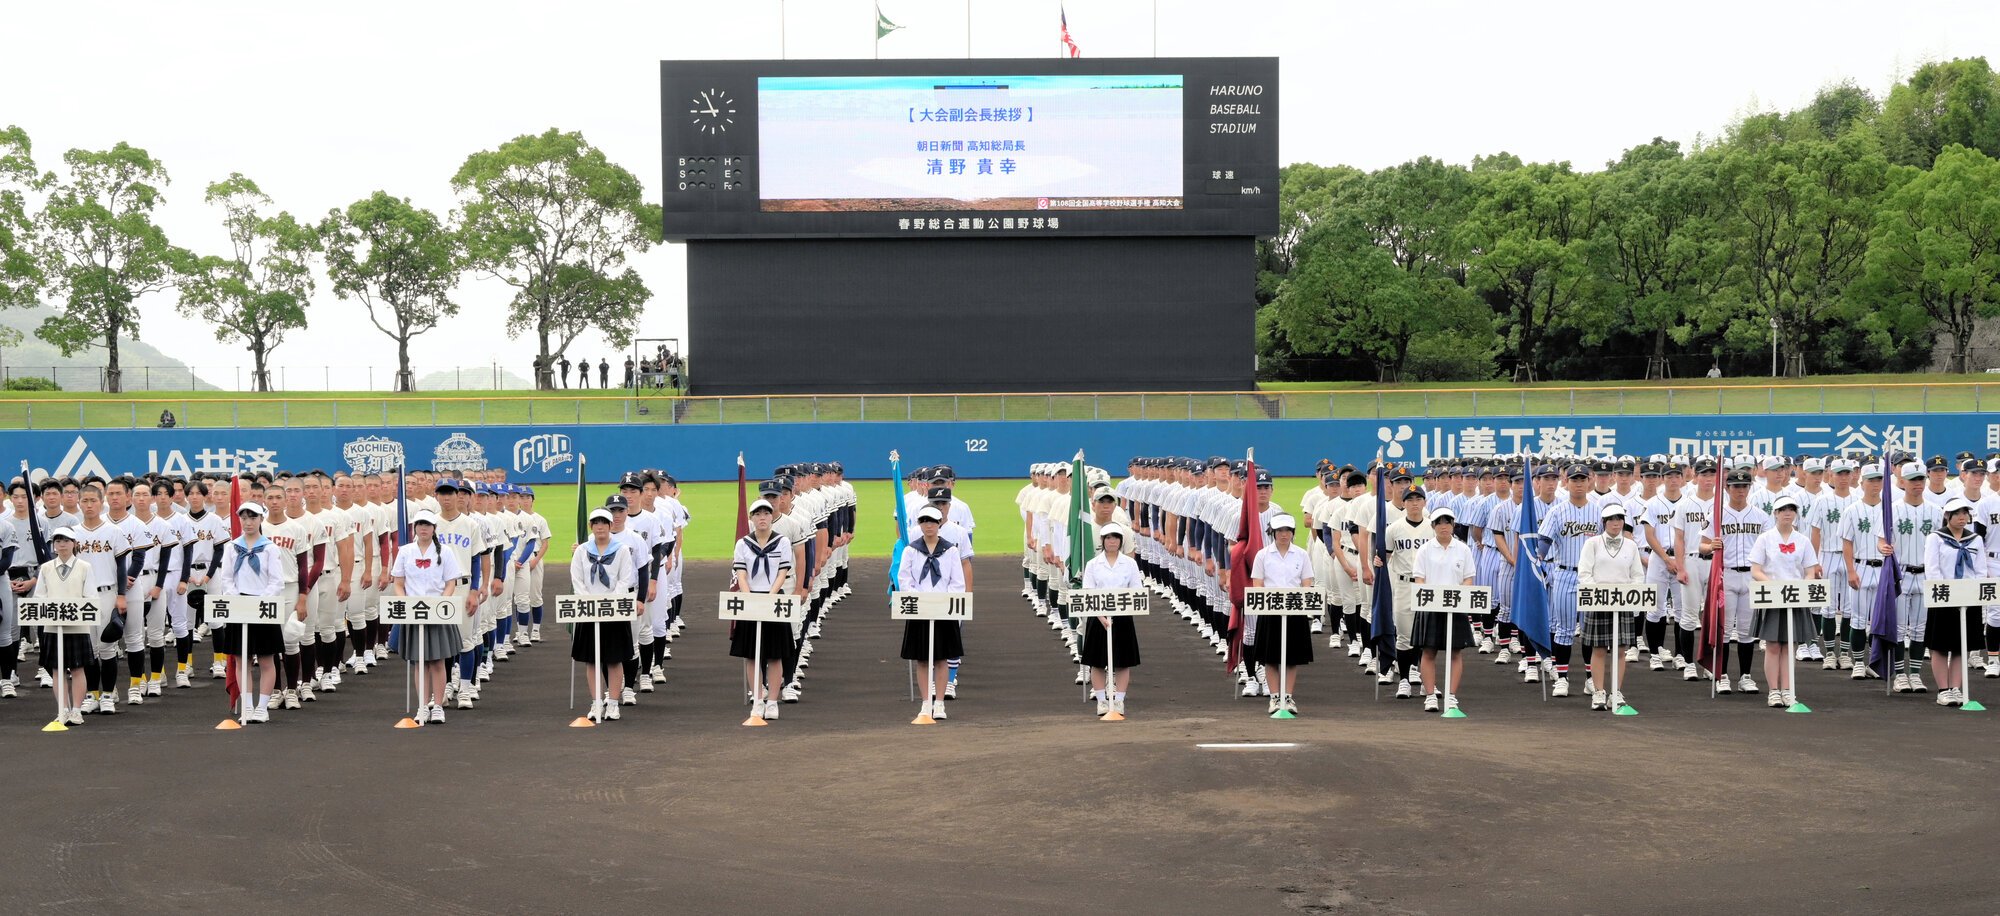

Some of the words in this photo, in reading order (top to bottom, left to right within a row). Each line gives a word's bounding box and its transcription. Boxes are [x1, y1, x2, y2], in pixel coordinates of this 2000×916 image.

[1210, 85, 1263, 96] HARUNO
[1210, 104, 1261, 115] BASEBALL
[1210, 123, 1256, 134] STADIUM
[917, 140, 963, 152] 朝日新聞
[967, 140, 1026, 152] 高知総局長
[679, 158, 686, 166] B
[724, 158, 731, 166] H
[679, 170, 686, 178] S
[724, 170, 731, 178] E
[679, 182, 686, 190] O
[1241, 186, 1261, 195] km/h
[898, 217, 1059, 230] 春野総合運動公園野球場
[350, 443, 396, 453] KOCHIEN
[965, 439, 988, 452] 122
[1421, 426, 1616, 467] 山善工務店
[514, 434, 572, 474] GOLD
[1686, 512, 1706, 523] TOSA
[1560, 520, 1598, 537] Kochi
[438, 533, 470, 548] AIYO
[1246, 591, 1323, 611] 明徳義塾
[1416, 588, 1488, 609] 伊野商
[1578, 586, 1656, 607] 高知丸の内
[1754, 584, 1827, 604] 土佐塾
[212, 600, 278, 619] 高知
[558, 597, 635, 618] 高知高専
[727, 596, 793, 618] 中村
[900, 595, 966, 616] 窪川
[1069, 591, 1148, 613] 高知追手前
[20, 600, 99, 622] 須崎総合
[387, 599, 456, 621] 連合①
